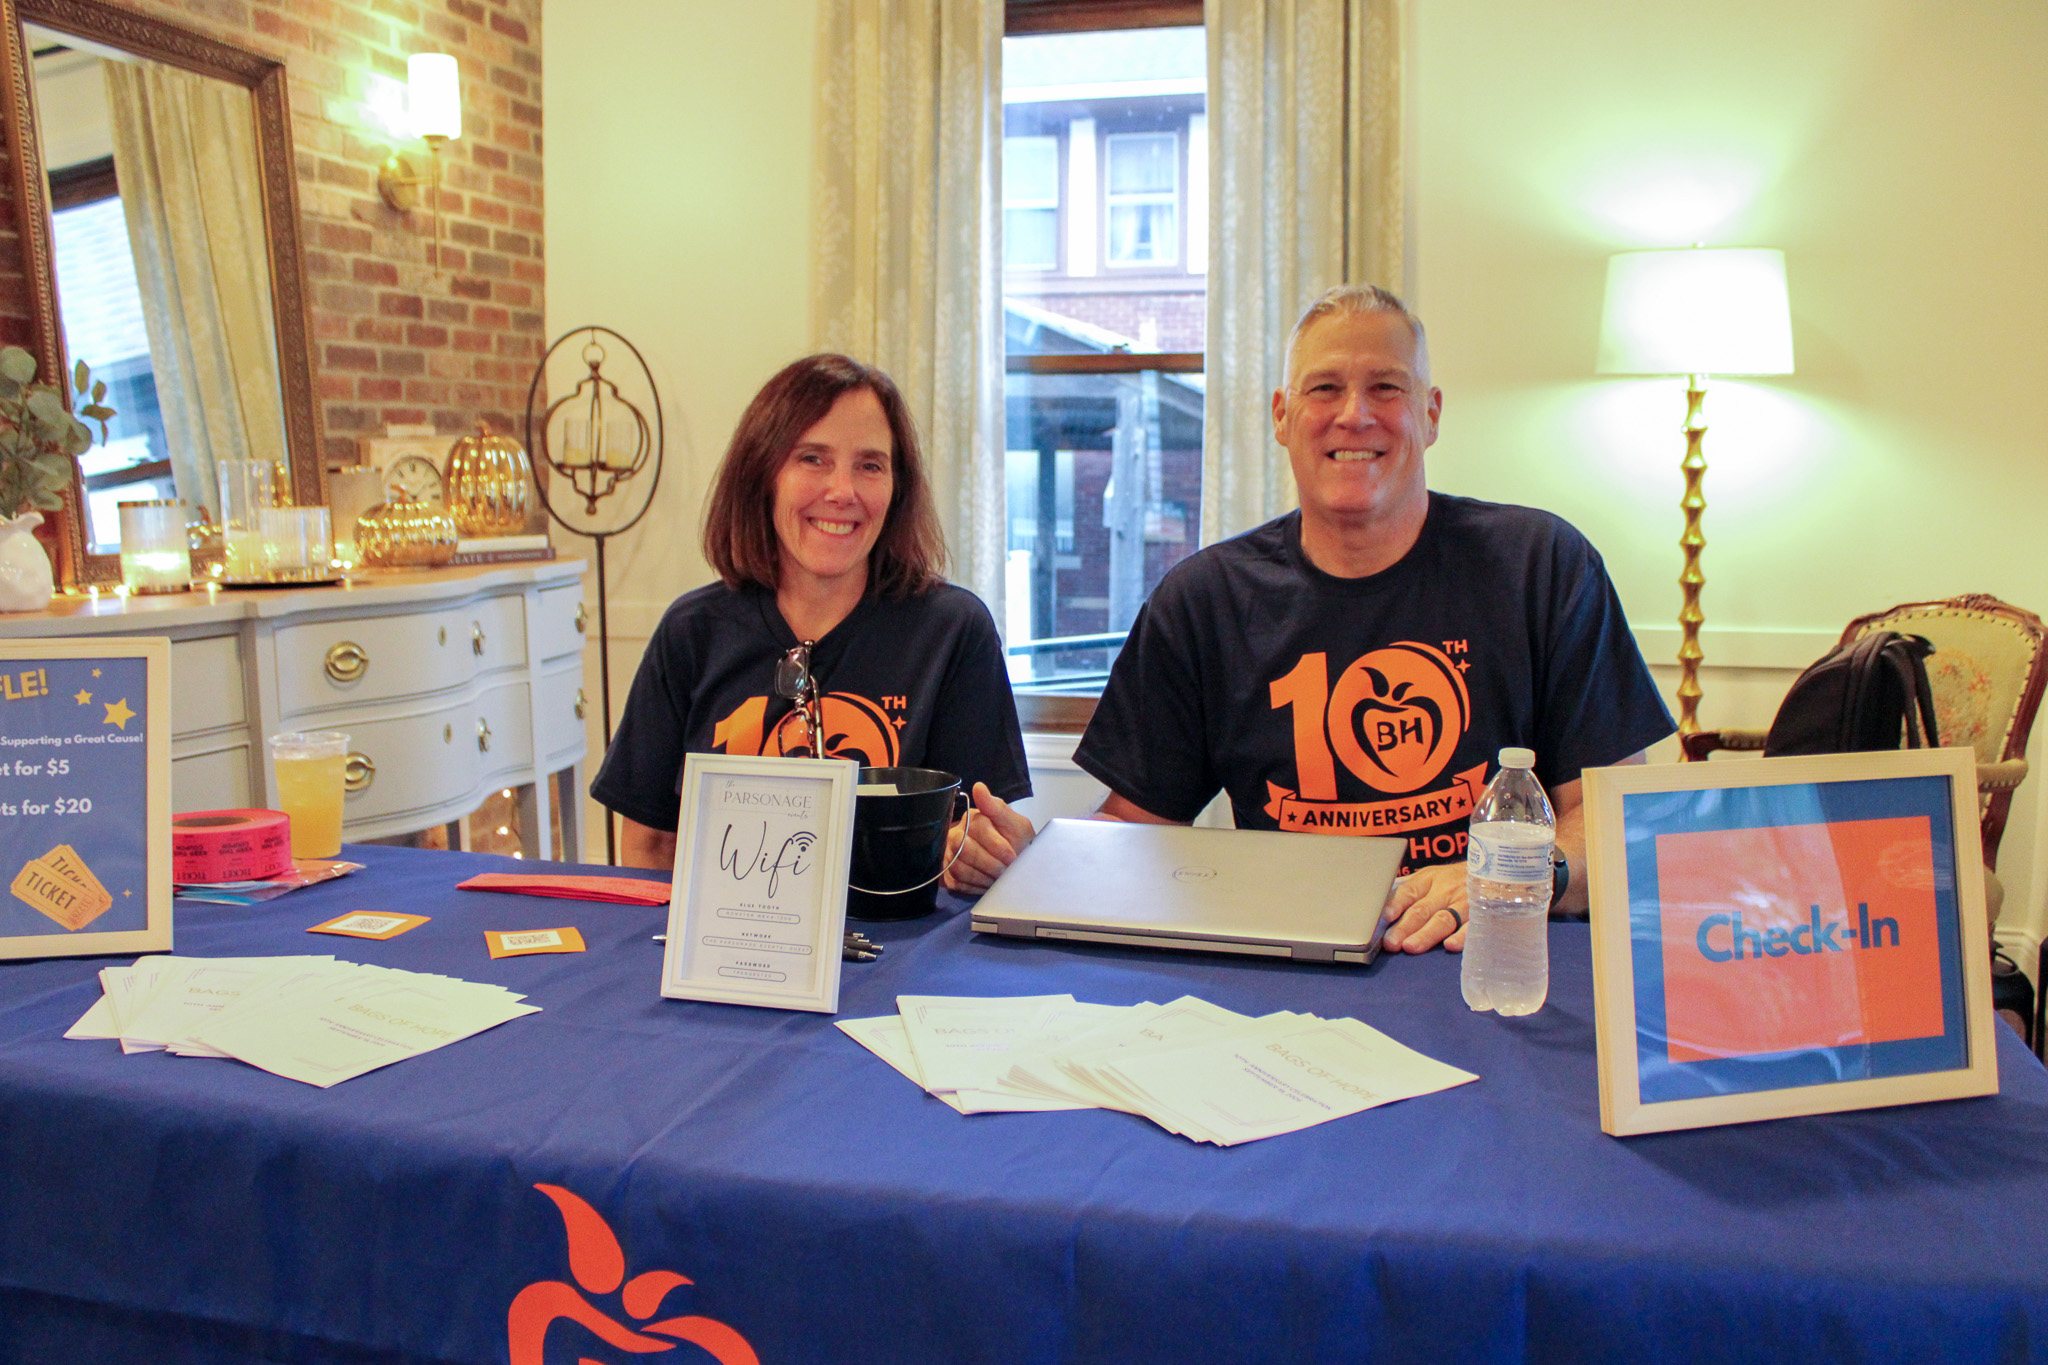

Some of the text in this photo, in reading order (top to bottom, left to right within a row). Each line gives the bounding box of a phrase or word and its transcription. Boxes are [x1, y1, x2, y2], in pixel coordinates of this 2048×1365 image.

[1442, 640, 1468, 654] TH
[0, 668, 49, 700] LE!
[881, 696, 907, 709] TH
[0, 732, 144, 748] Supporting a Great Cause!
[1376, 717, 1424, 752] BH
[14, 759, 42, 776] for
[46, 757, 70, 777] $5
[0, 796, 93, 816] ts for $20
[723, 790, 812, 809] PARSONAGE
[1302, 796, 1453, 828] ANNIVERSARY
[720, 820, 811, 899] Wifi
[1409, 831, 1470, 860] HOP
[26, 871, 77, 910] TICKET
[1696, 902, 1900, 963] Check-In
[1265, 1043, 1381, 1101] BAGS OF HOPE
